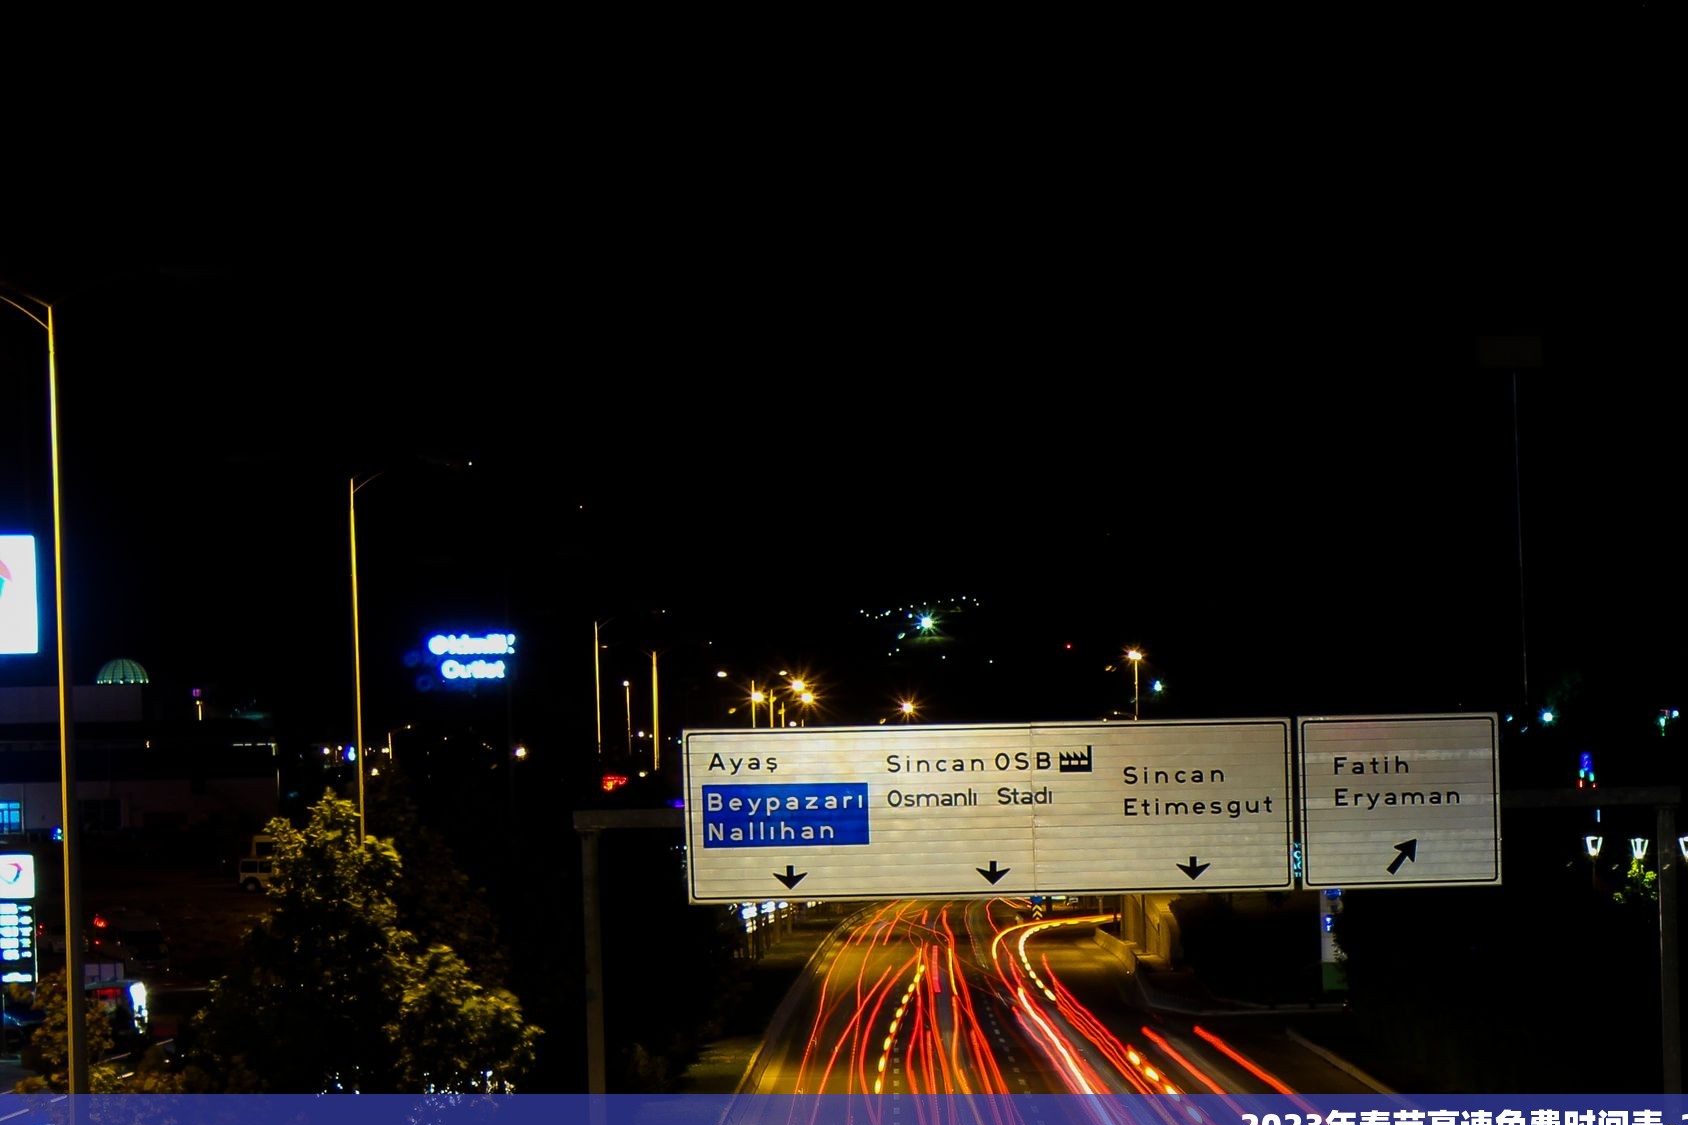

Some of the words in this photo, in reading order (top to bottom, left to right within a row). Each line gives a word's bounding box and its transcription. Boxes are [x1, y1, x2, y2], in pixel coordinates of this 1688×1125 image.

[708, 752, 778, 774] Ayaş
[887, 754, 984, 773] Sincan
[995, 752, 1051, 771] OSB
[1333, 755, 1410, 775] Fatih
[1123, 766, 1225, 785] Sincan
[707, 793, 863, 816] Beypazarı
[887, 788, 977, 808] Osmanlı
[997, 786, 1053, 805] Stadı
[1123, 796, 1273, 819] Etimesgut
[1334, 788, 1461, 811] Eryaman
[708, 822, 834, 841] Nallıhan
